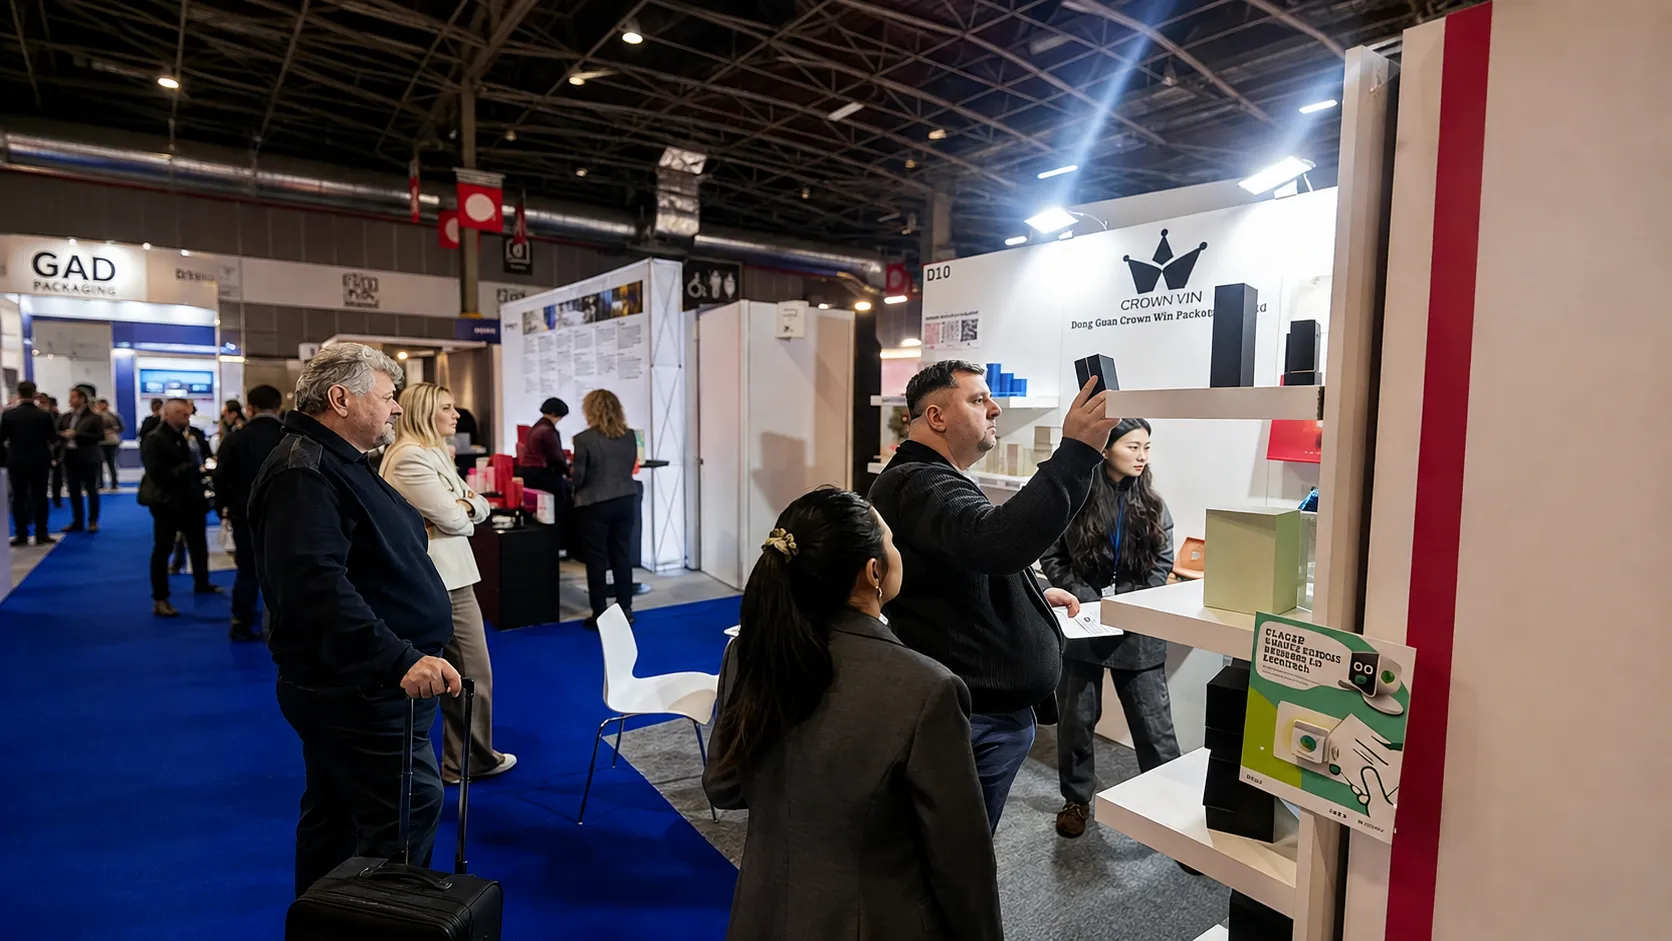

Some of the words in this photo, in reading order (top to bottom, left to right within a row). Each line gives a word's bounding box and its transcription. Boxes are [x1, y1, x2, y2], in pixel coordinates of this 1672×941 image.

[32, 252, 116, 282] GAD
[927, 265, 951, 281] D10
[33, 281, 116, 295] PACKAGING
[1120, 294, 1174, 311] CROWN
[1176, 290, 1203, 305] VIN
[1071, 320, 1094, 330] Dong
[1095, 318, 1118, 327] Guan
[1120, 315, 1151, 325] Crown
[1153, 311, 1174, 322] Win
